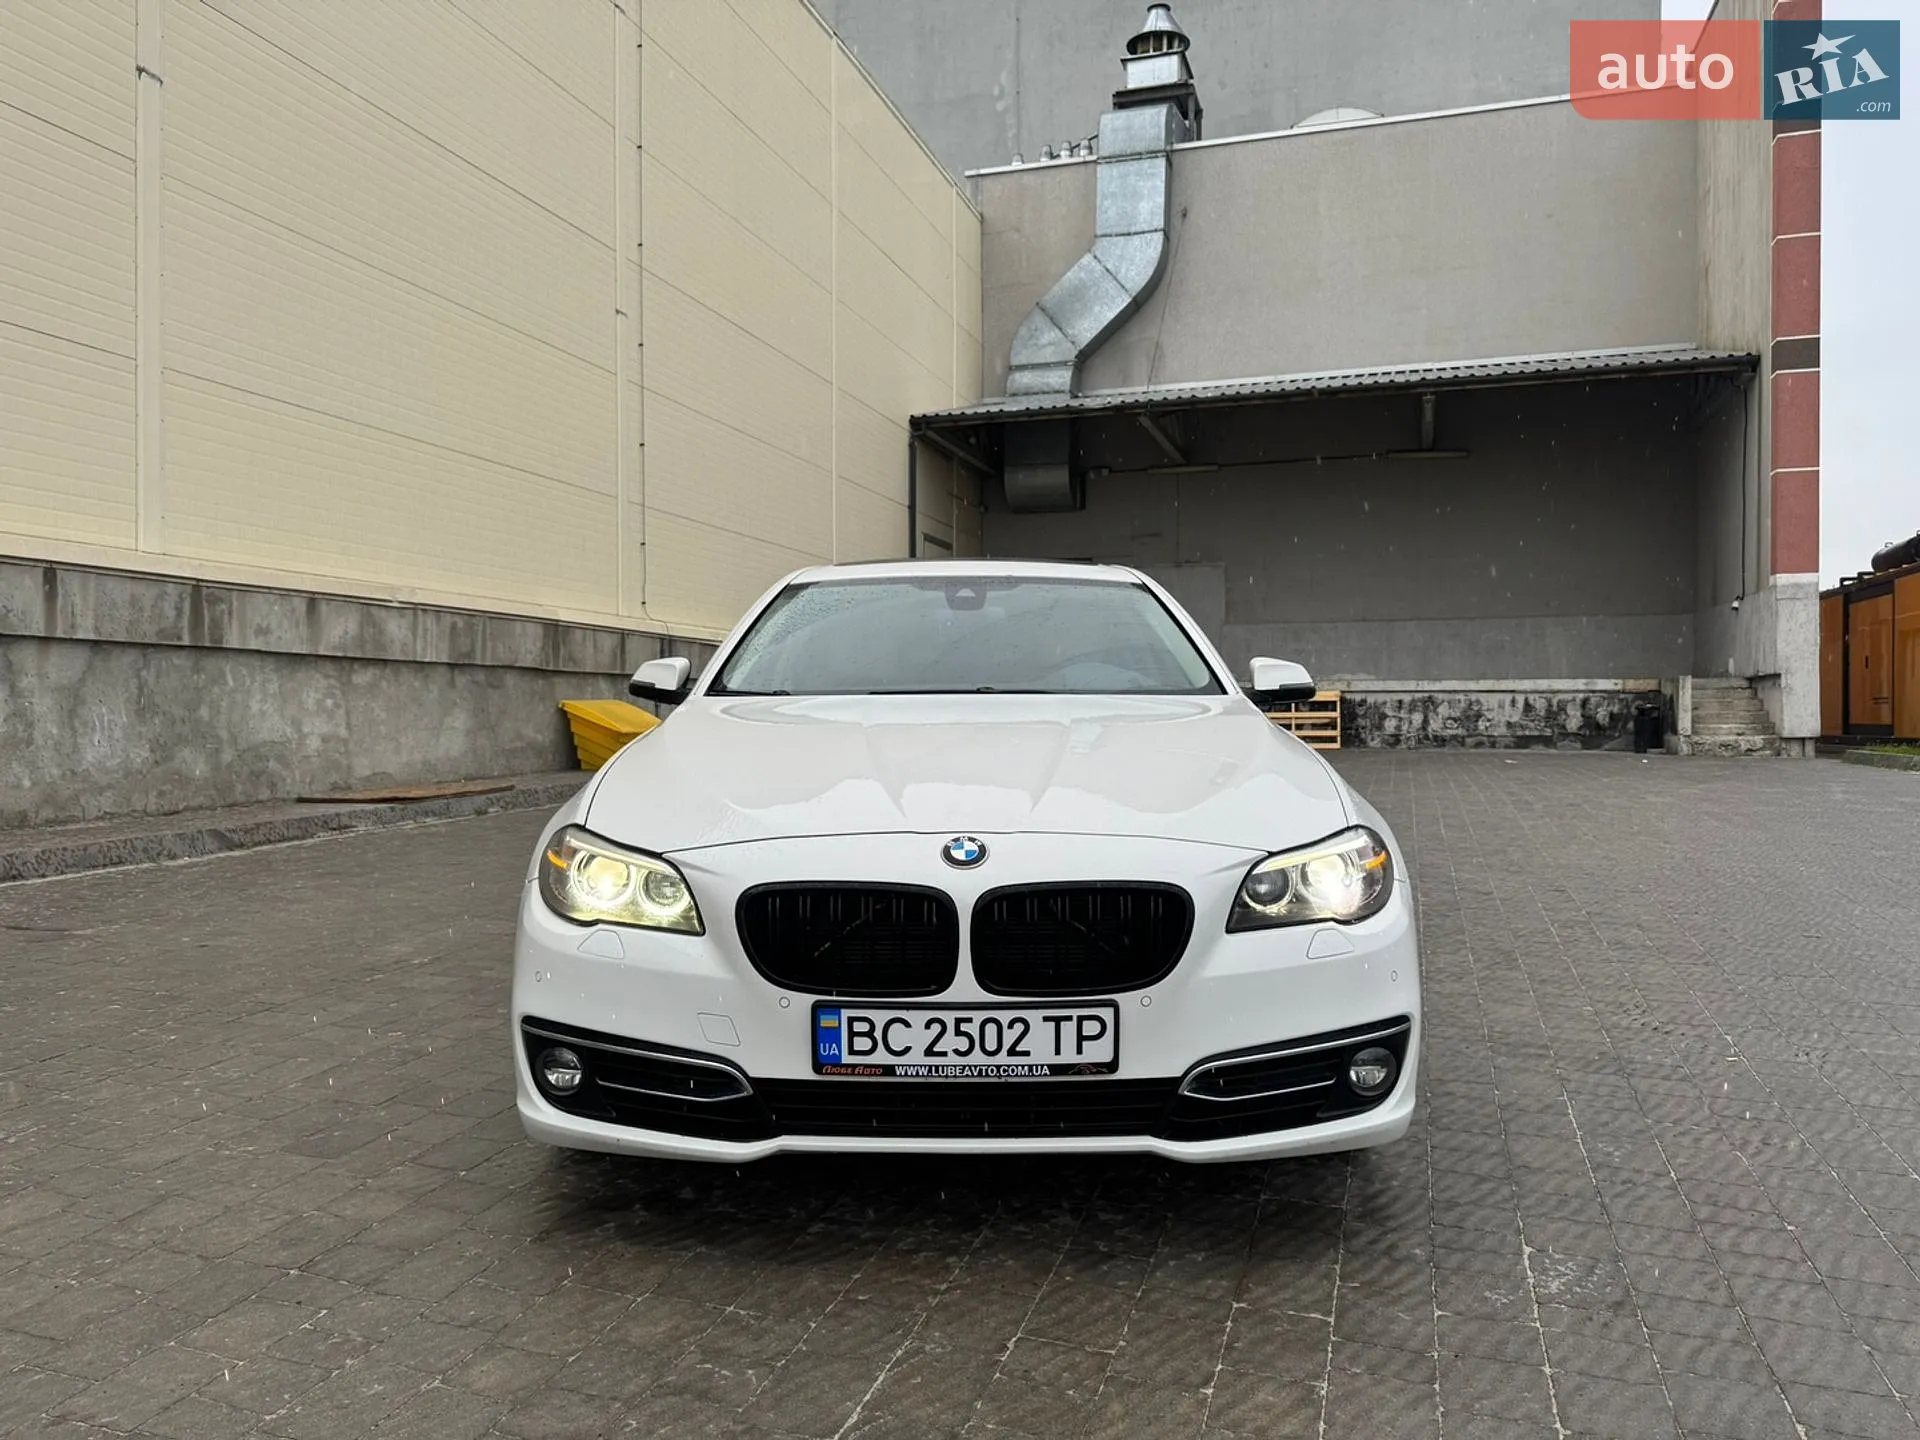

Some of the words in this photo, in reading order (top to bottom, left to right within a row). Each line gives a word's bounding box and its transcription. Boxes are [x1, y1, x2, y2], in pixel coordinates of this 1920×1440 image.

[846, 1015, 913, 1057] BC
[923, 1016, 1031, 1057] 2502
[1042, 1014, 1108, 1056] TP
[819, 1043, 840, 1056] UA
[895, 1065, 1050, 1077] WWW.LUBEAVTO.COM.UA
